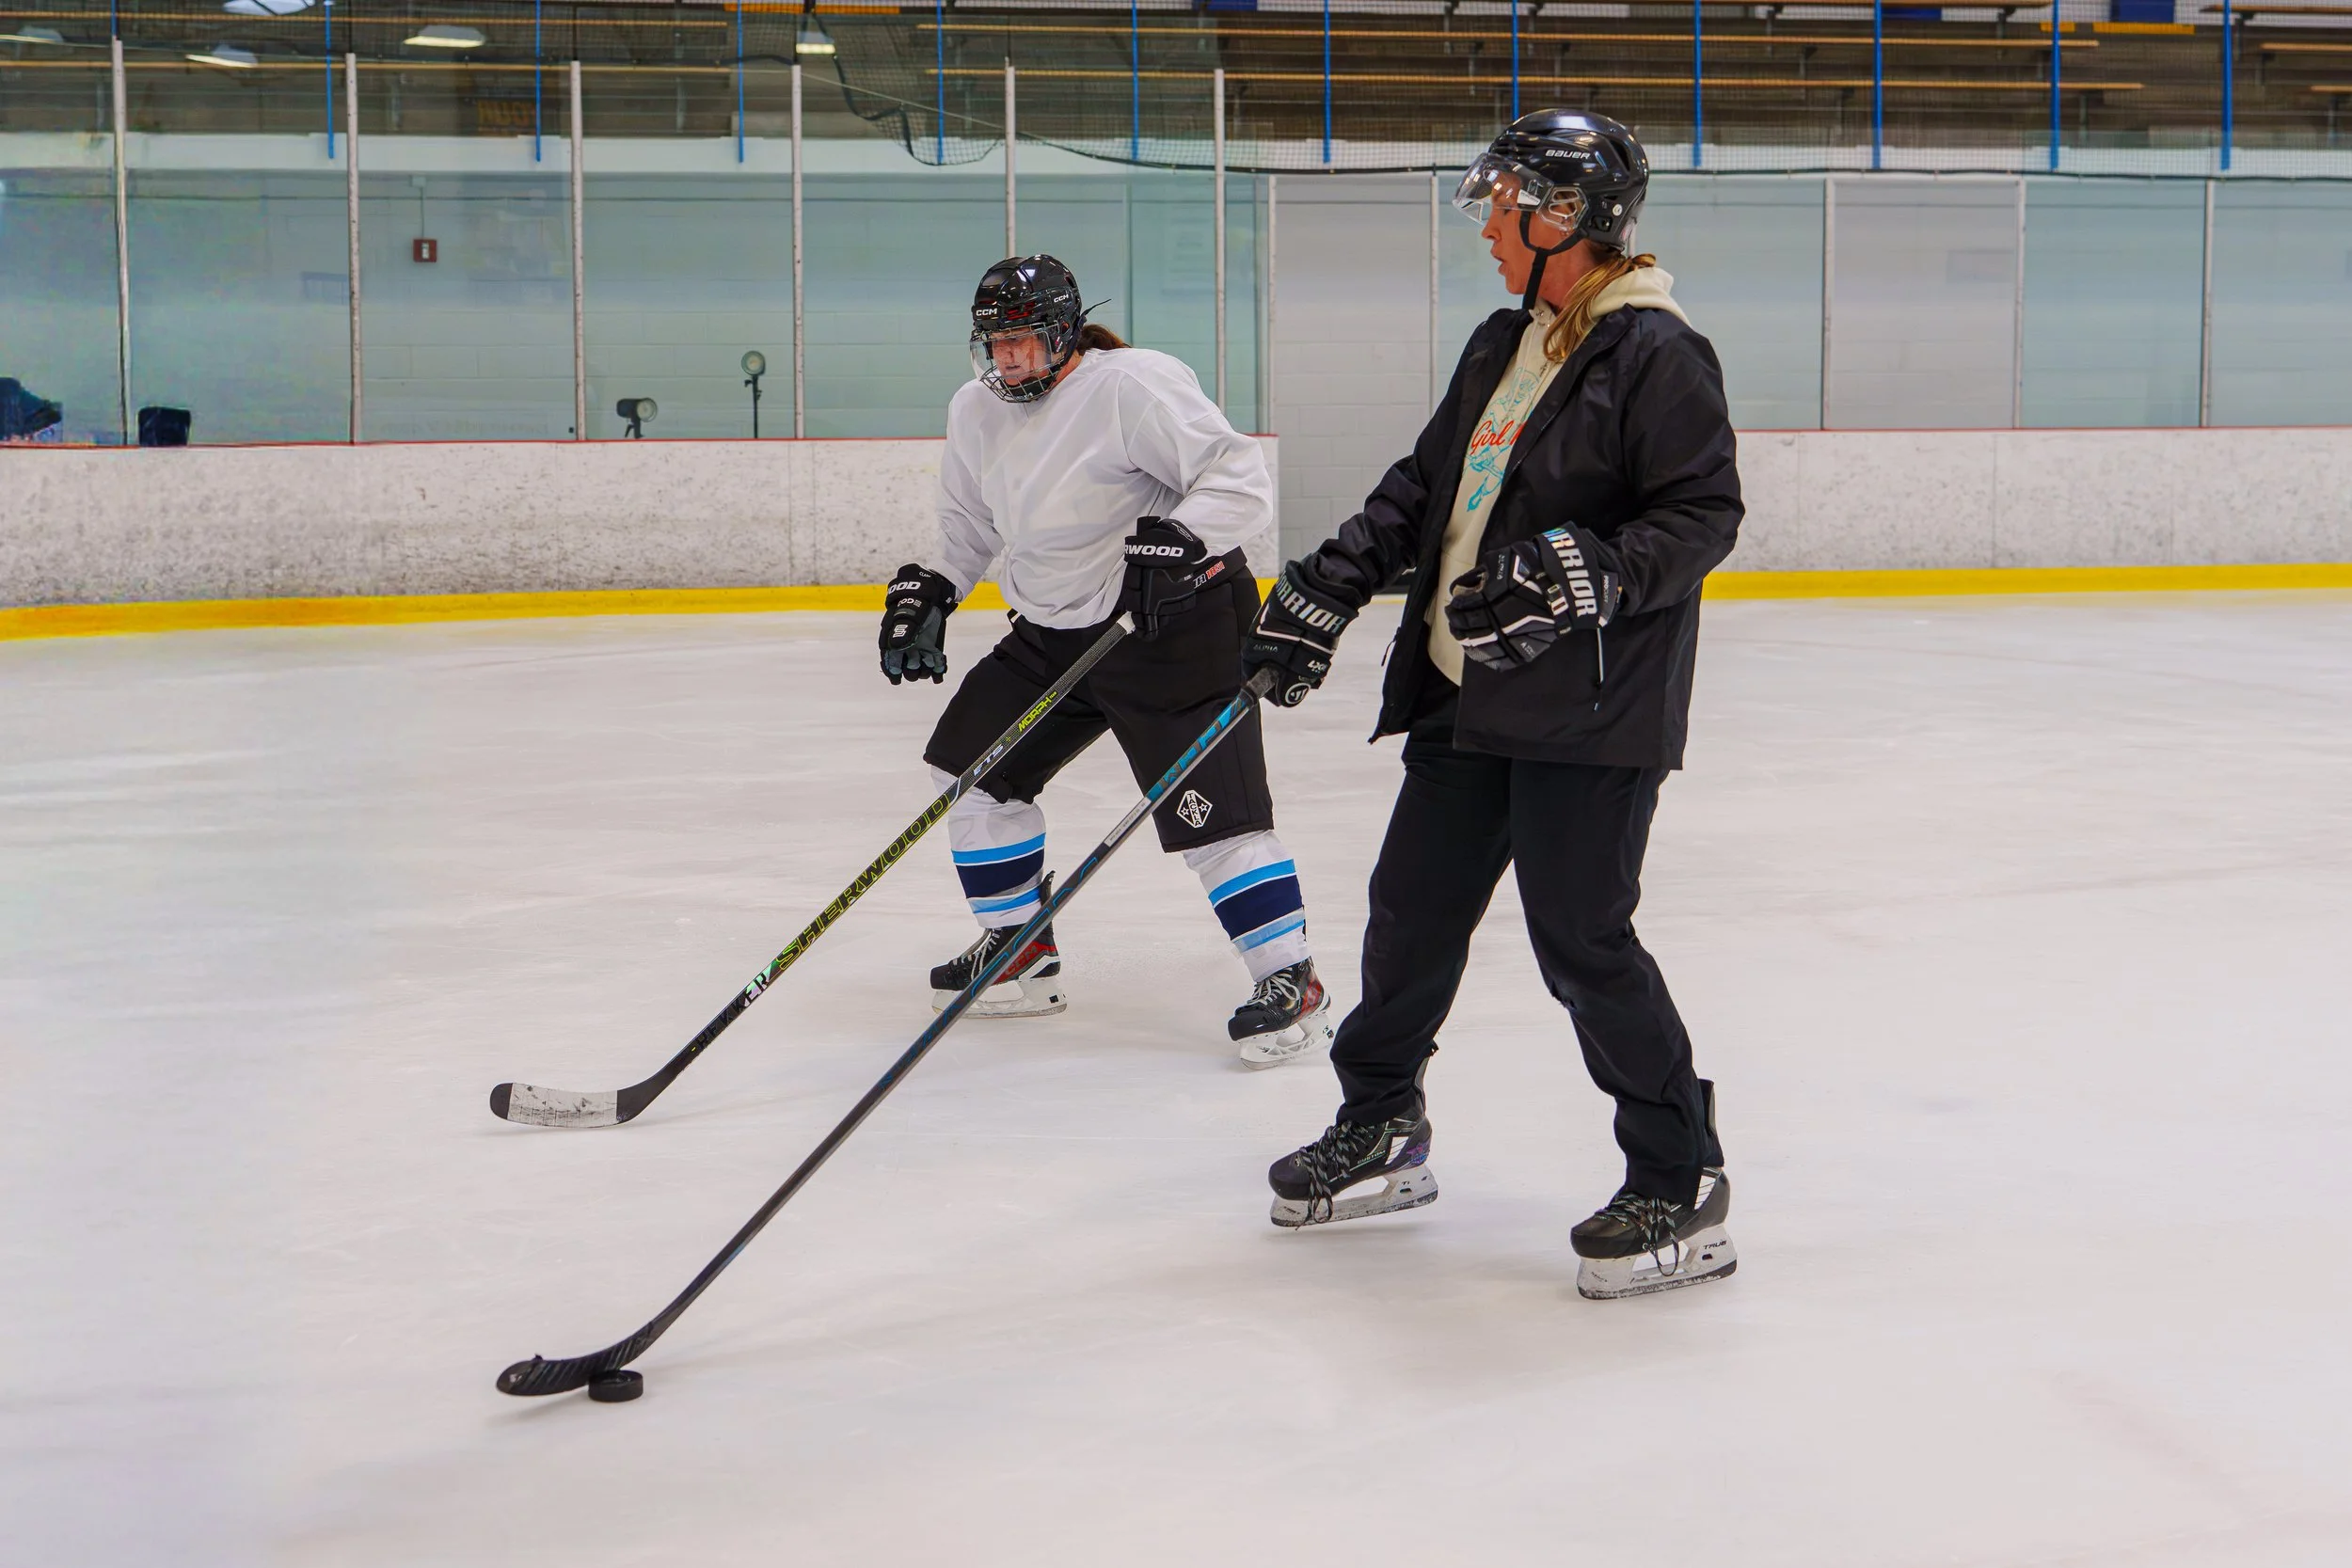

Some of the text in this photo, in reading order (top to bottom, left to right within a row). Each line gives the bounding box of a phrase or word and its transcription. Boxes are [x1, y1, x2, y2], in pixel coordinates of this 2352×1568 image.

[1545, 149, 1591, 160] BAUER
[1054, 293, 1070, 304] CCM
[976, 308, 998, 317] CCM
[1470, 420, 1516, 456] Girl
[1018, 696, 1052, 732] MORPH
[1185, 792, 1202, 827] TACKLA
[775, 794, 951, 971] SHERWOOD
[1702, 1240, 1727, 1250] TRUE
